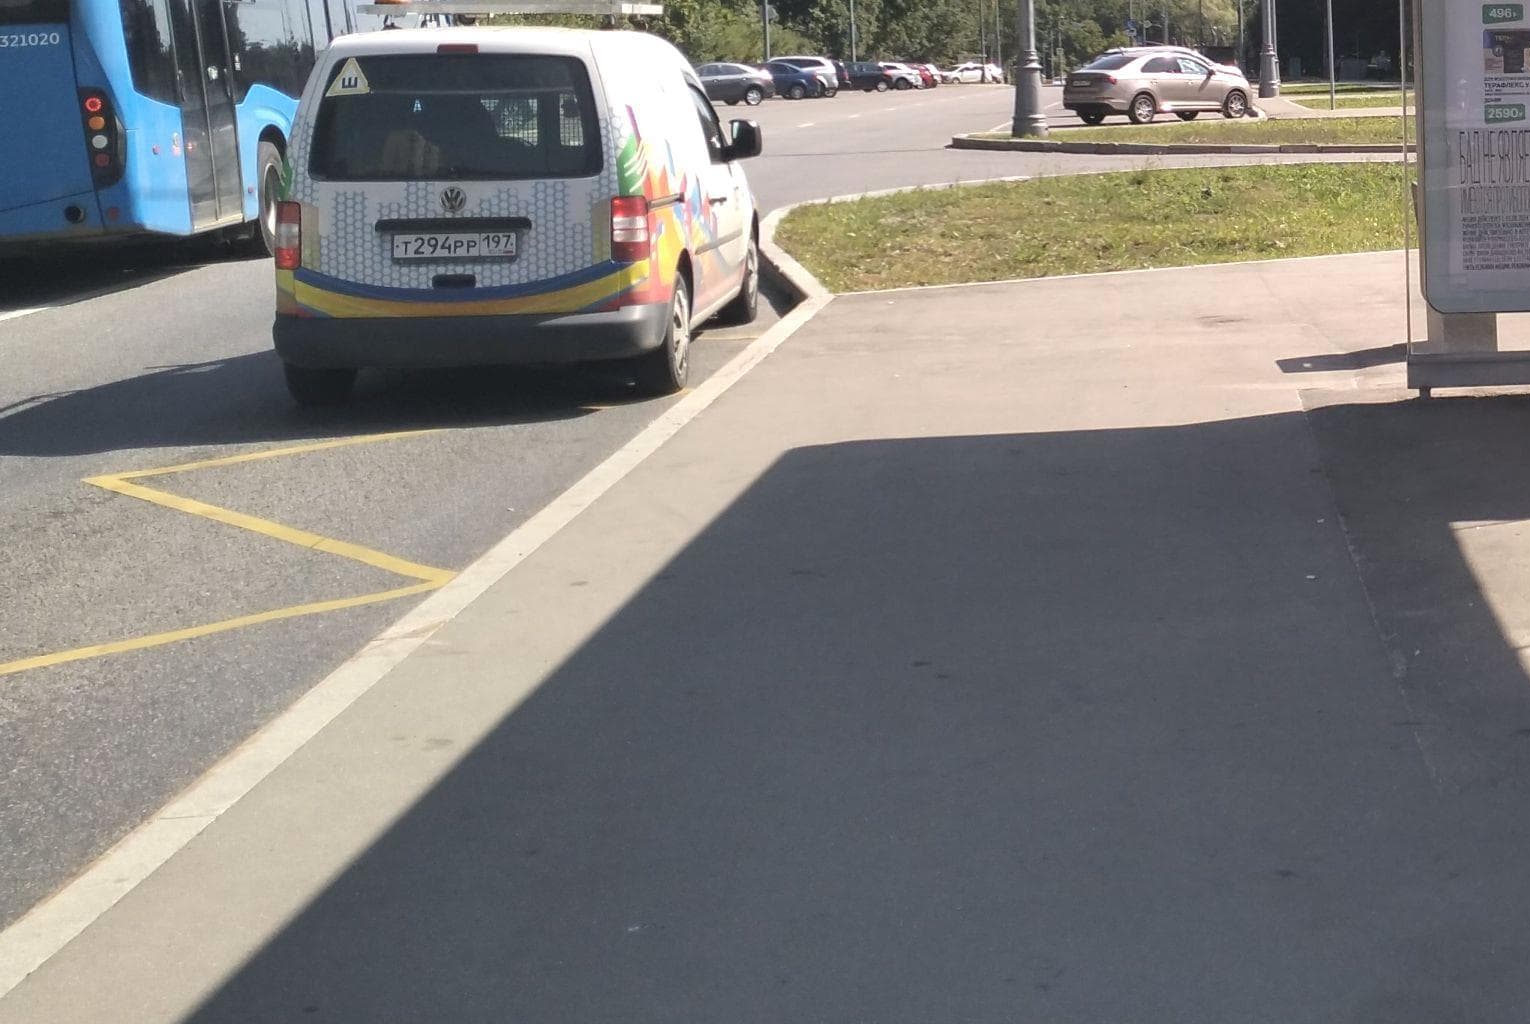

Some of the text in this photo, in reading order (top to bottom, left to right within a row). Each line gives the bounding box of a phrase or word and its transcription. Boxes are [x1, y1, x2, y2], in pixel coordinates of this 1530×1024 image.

[0, 31, 60, 48] 321020
[341, 76, 358, 89] Ш
[482, 234, 511, 249] 197
